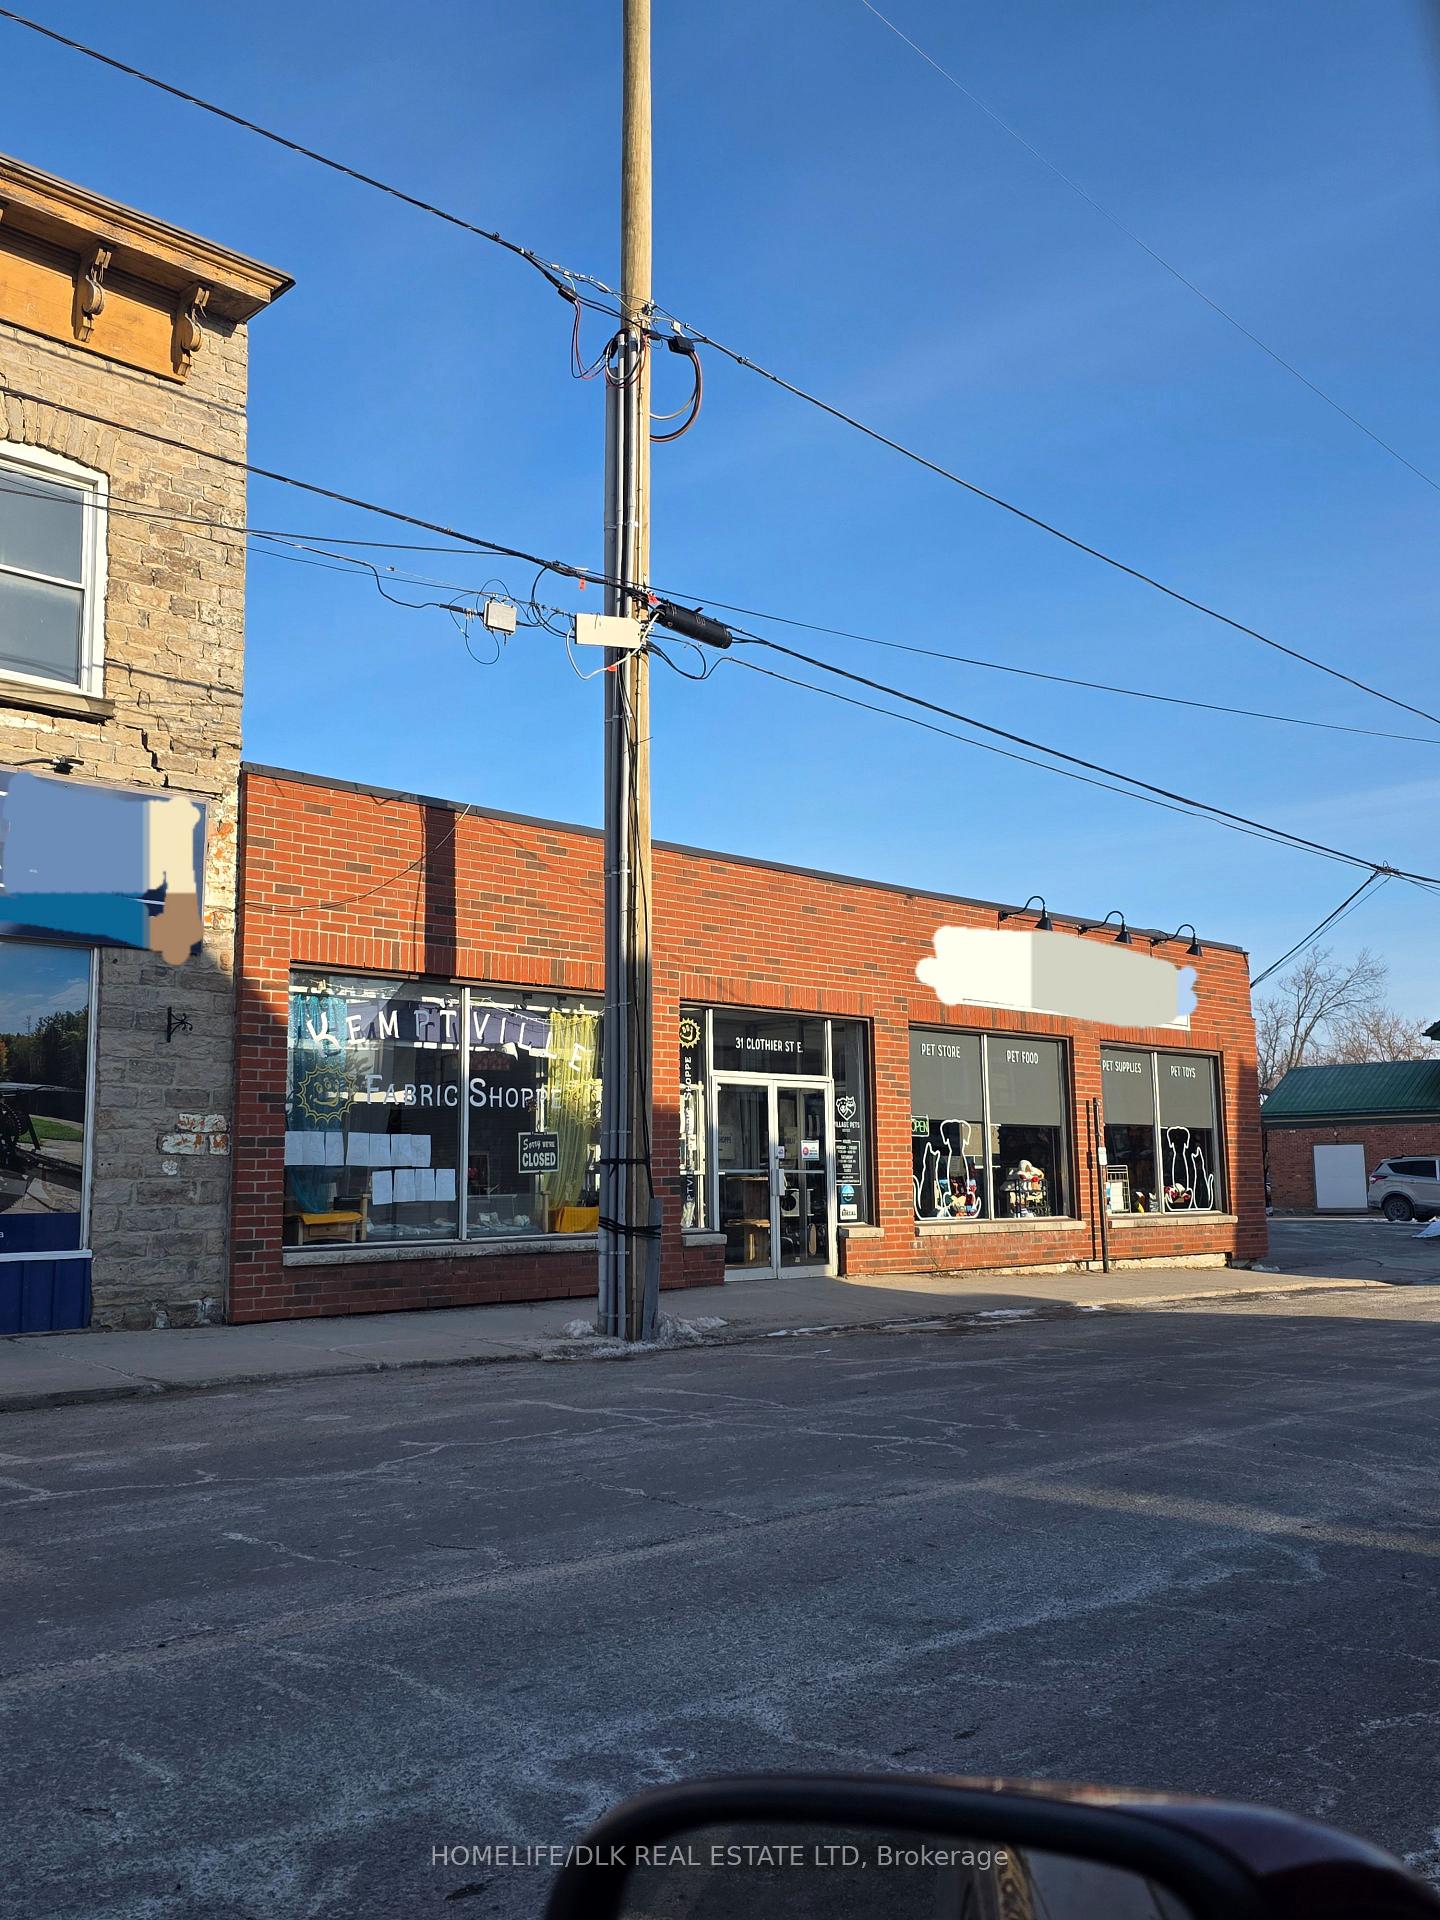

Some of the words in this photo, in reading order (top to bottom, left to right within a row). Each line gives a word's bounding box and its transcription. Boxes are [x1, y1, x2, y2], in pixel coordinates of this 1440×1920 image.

[306, 1010, 589, 1072] KEMPTVILLE
[735, 1037, 744, 1049] 31
[746, 1037, 783, 1051] CLOTHIER
[785, 1041, 795, 1052] ST
[796, 1041, 803, 1053] E
[921, 1043, 936, 1056] PET
[938, 1044, 961, 1059] STORE
[1006, 1050, 1019, 1063] PET
[1021, 1051, 1039, 1064] FOOD
[1102, 1060, 1114, 1072] PET
[1115, 1061, 1142, 1074] SUPPLIES
[1170, 1065, 1181, 1078] PET
[1182, 1066, 1196, 1078] TOYS
[684, 1056, 692, 1101] SHOPPE
[365, 1074, 458, 1107] FABRIC
[469, 1077, 562, 1109] SHOPPE
[912, 1119, 929, 1134] OPEN
[522, 1152, 556, 1167] CLOSED
